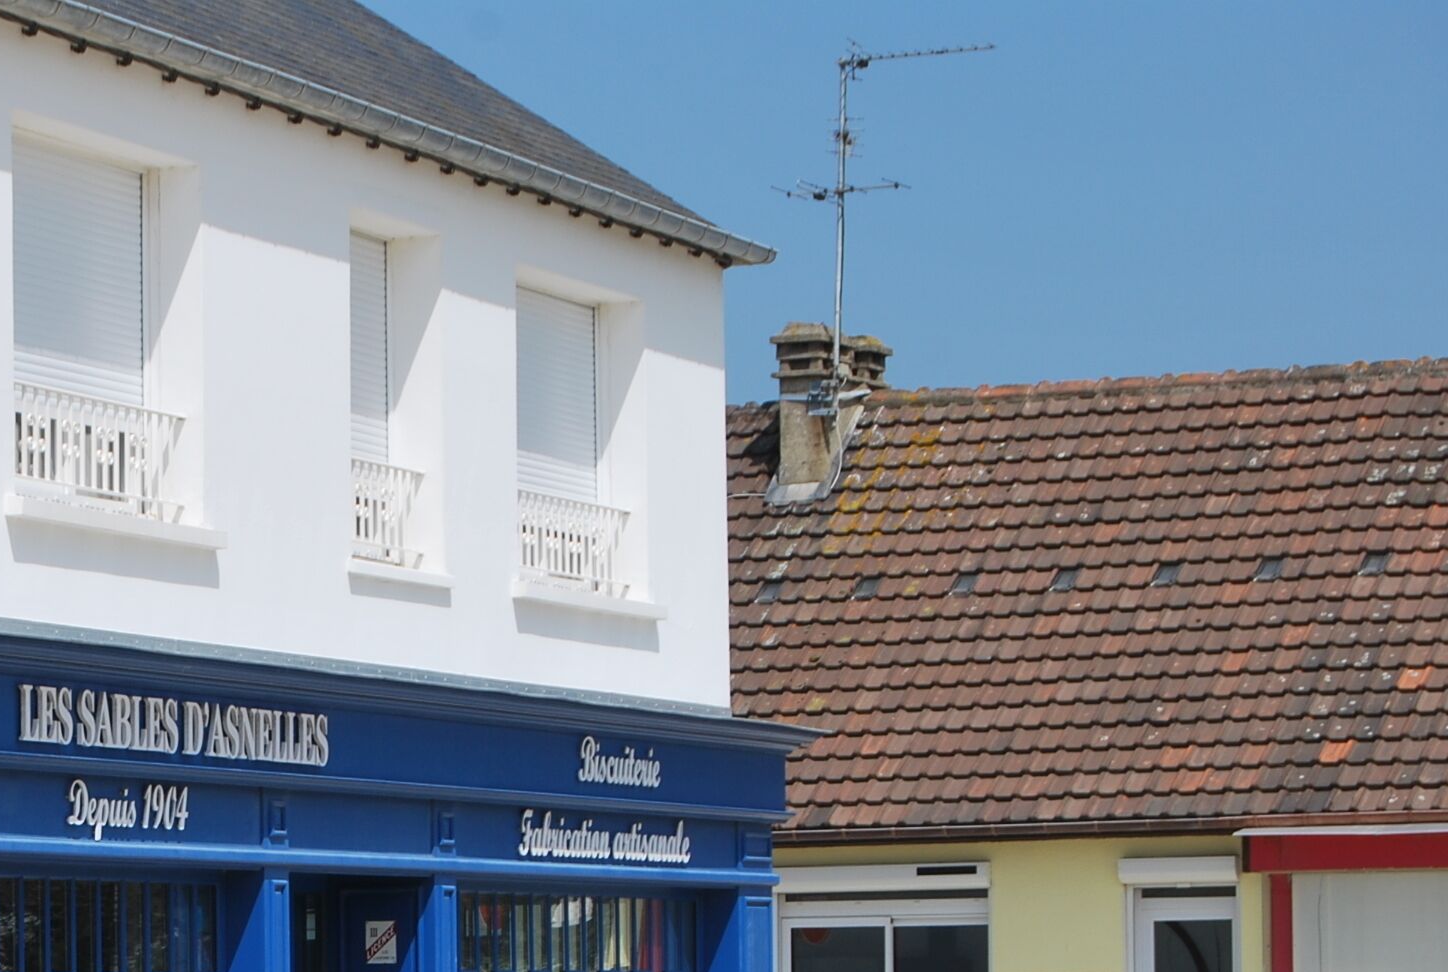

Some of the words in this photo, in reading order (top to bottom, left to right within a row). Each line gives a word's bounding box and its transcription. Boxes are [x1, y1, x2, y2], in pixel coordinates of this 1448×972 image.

[18, 684, 73, 745] LES
[77, 689, 179, 755] SABLES
[182, 701, 329, 767] D'ASNELLES
[578, 736, 661, 788] Biscuiterie
[66, 778, 137, 841] Depuis
[142, 784, 189, 831] 1904
[519, 808, 611, 860] Fabrication
[612, 820, 691, 864] artisanale
[366, 925, 397, 961] LICENCE
